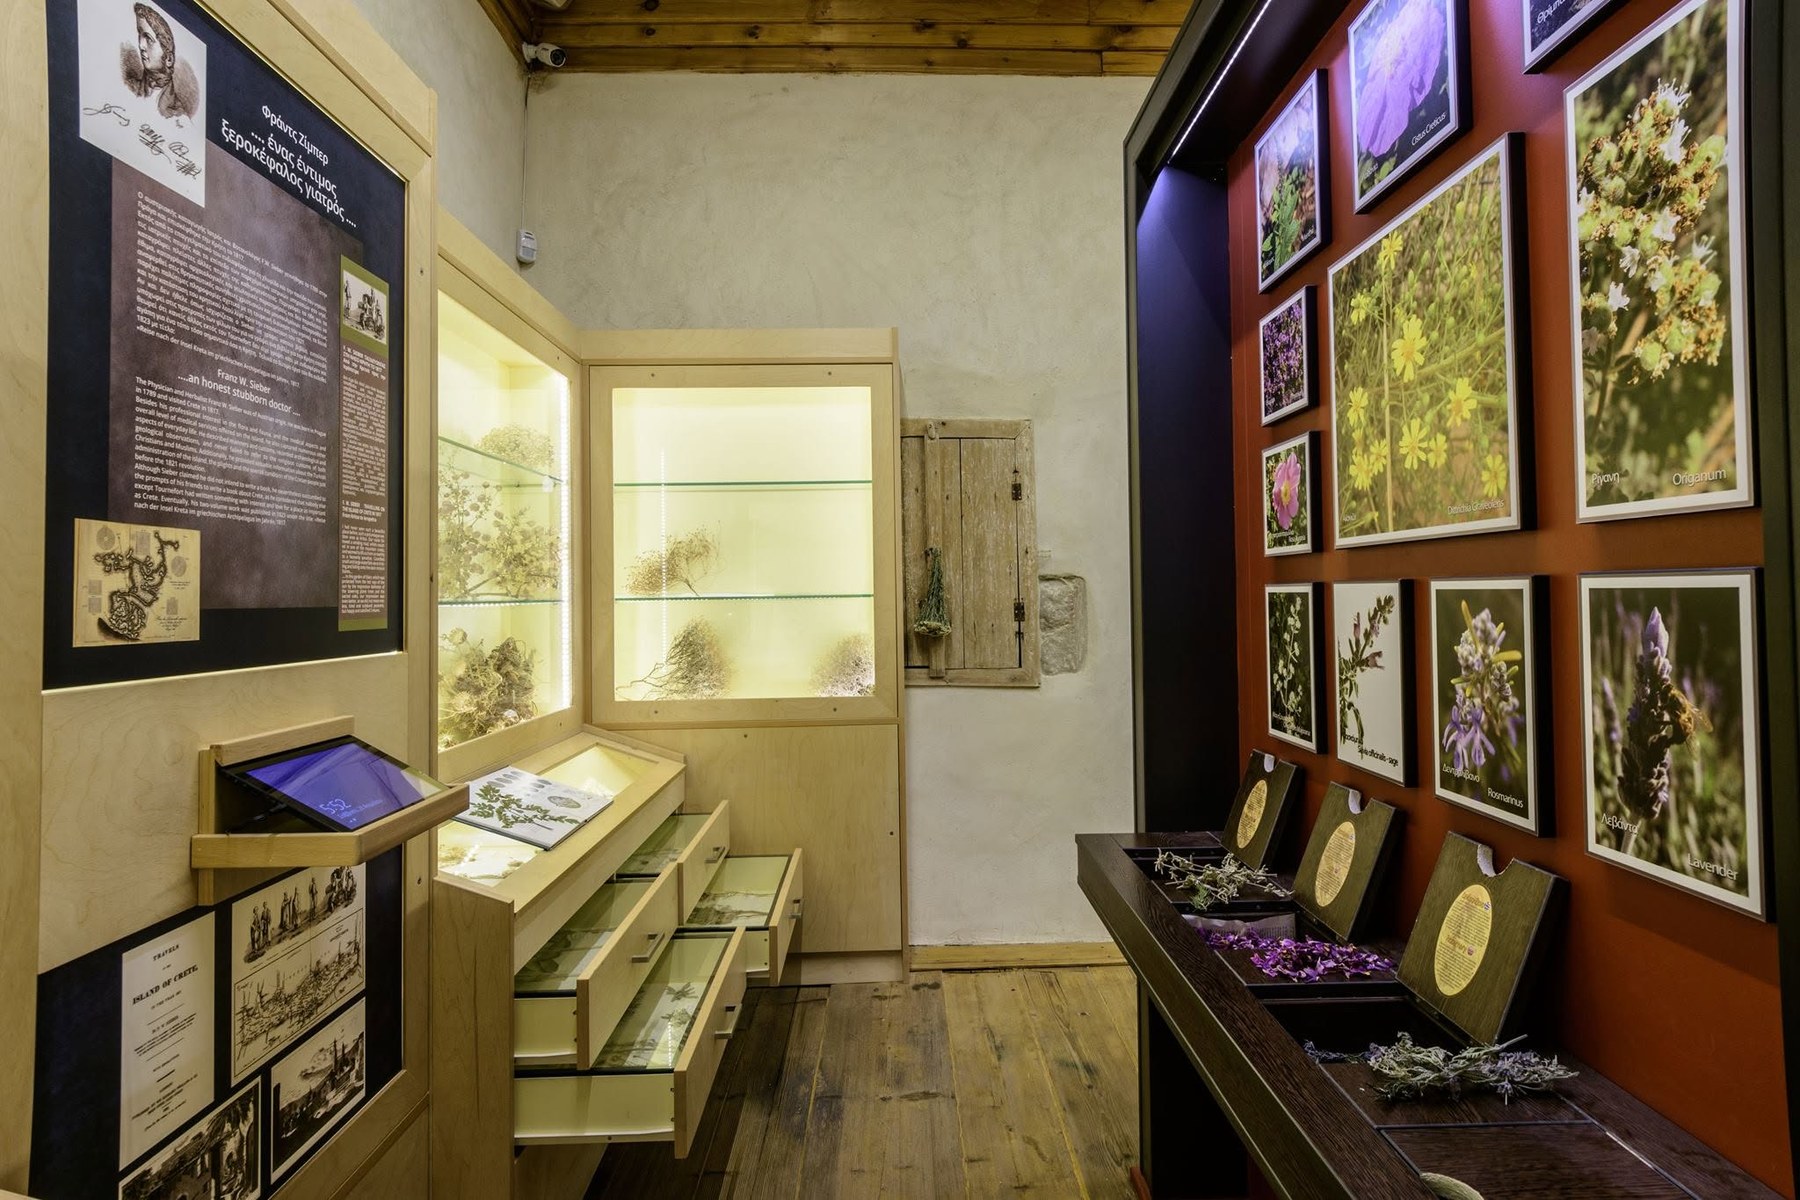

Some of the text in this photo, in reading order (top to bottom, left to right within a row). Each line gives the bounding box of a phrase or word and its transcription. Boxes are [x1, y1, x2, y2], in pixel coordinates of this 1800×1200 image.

[262, 105, 329, 167] Φράντς Ζίμπερ
[221, 118, 303, 193] ξεροκέφαλος
[304, 182, 345, 222] γιατρός
[267, 133, 295, 169] ένας
[296, 155, 337, 199] έντιμος
[201, 376, 231, 395] honest
[232, 388, 268, 406] stubborn
[268, 399, 292, 413] doctor
[218, 369, 271, 394] Franz W. Sieber
[1591, 472, 1620, 486] Ρίγανη
[1672, 469, 1727, 487] Origanum
[1487, 787, 1524, 809] Rosmarinus
[1601, 813, 1639, 834] Λεβάντα
[1687, 853, 1739, 880] Lavender
[132, 984, 160, 1005] ISLAND
[162, 977, 173, 989] OF
